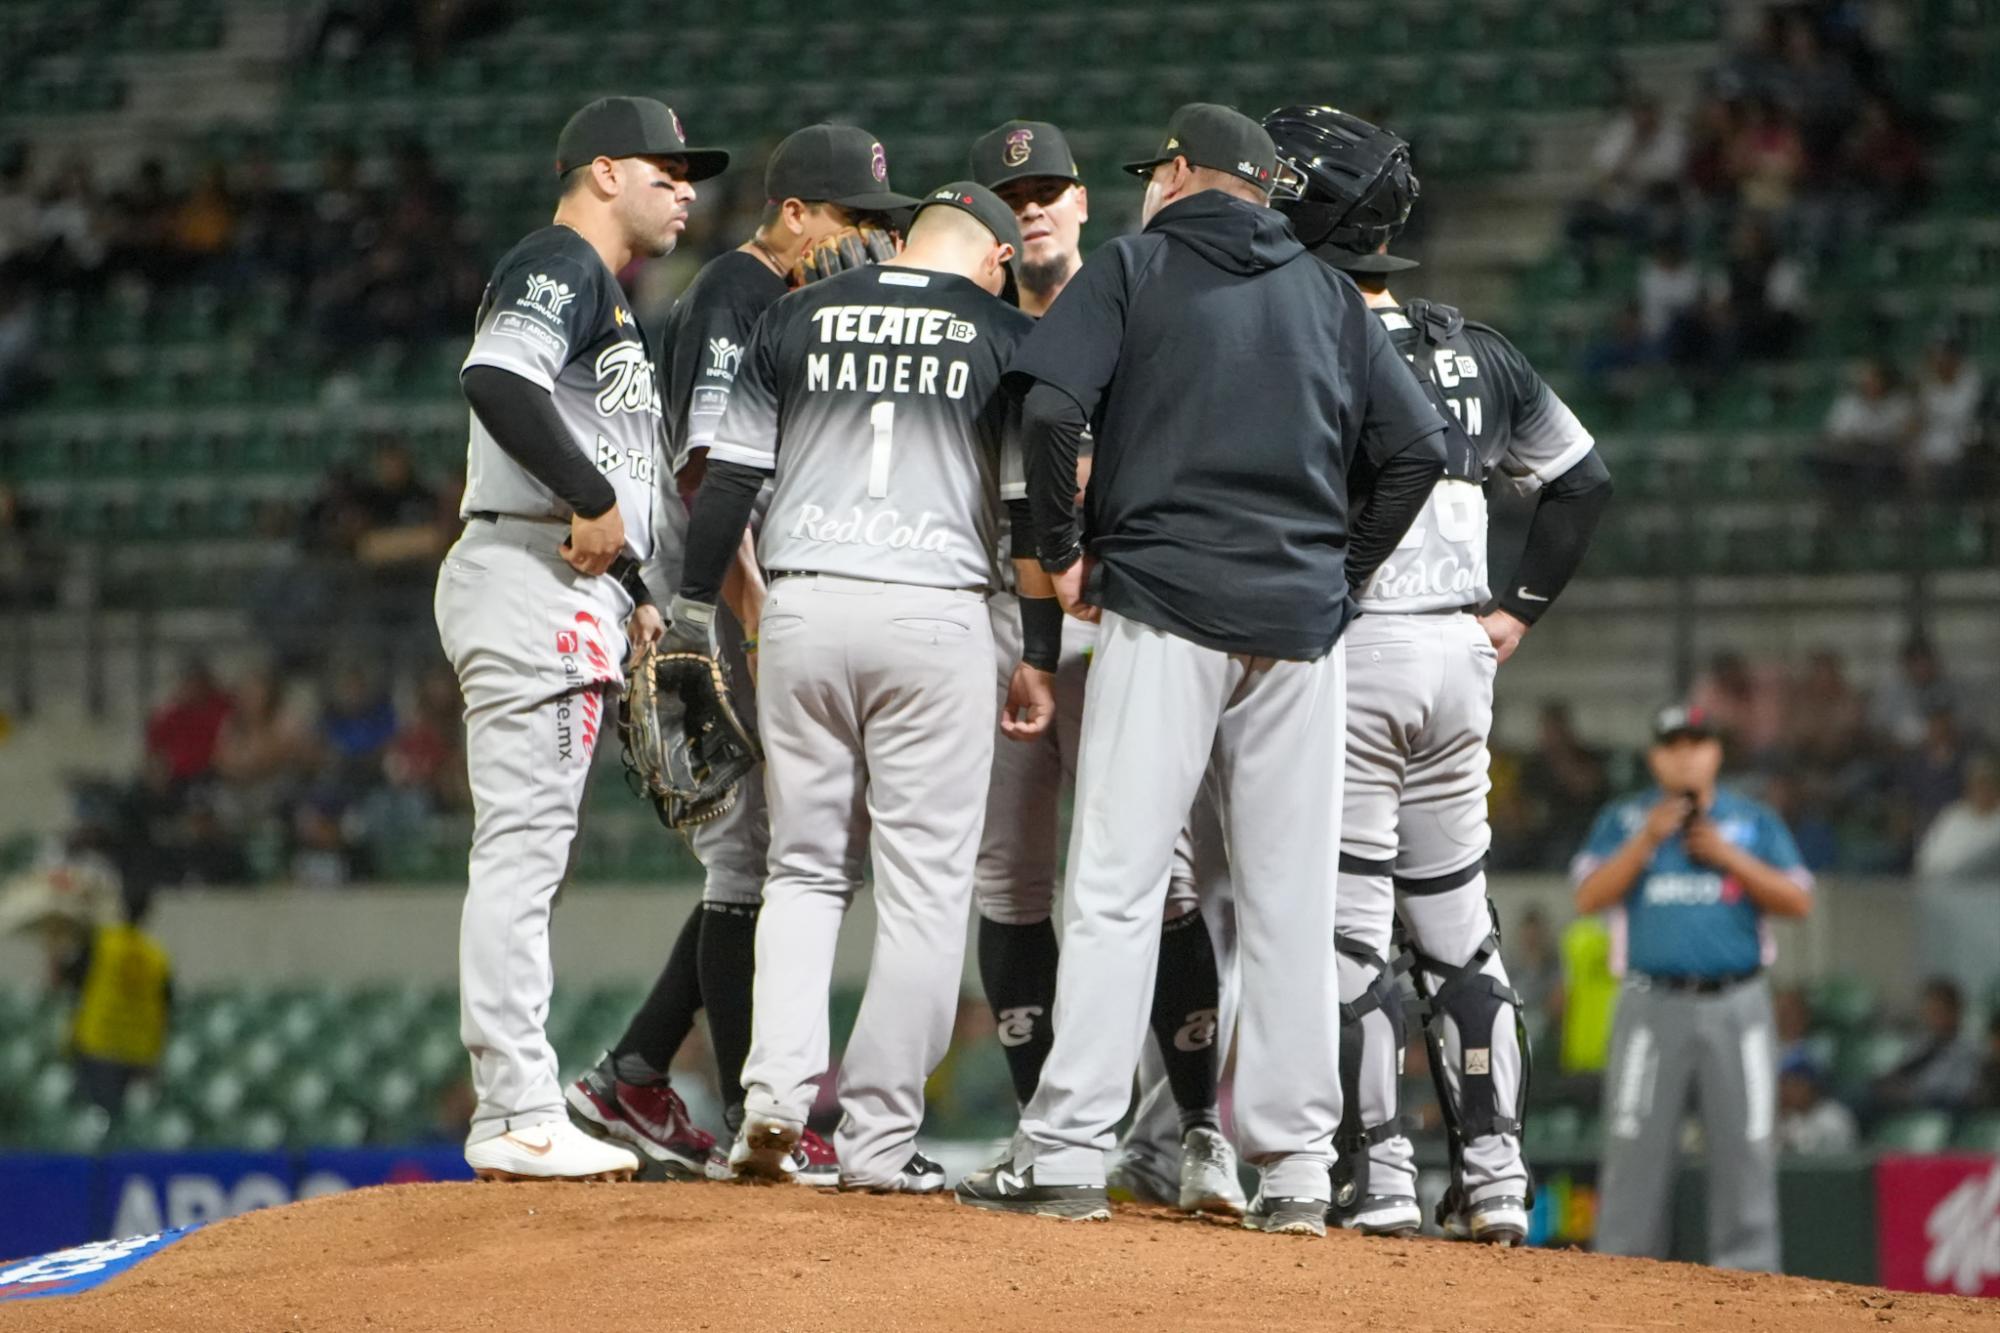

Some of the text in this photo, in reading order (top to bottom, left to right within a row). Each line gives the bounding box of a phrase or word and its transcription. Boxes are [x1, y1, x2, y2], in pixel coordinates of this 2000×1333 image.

[516, 298, 565, 326] INFONAVIT
[811, 305, 956, 345] TECATE
[807, 352, 970, 400] MADERO
[868, 401, 896, 499] 1
[556, 655, 585, 762] calite.mx
